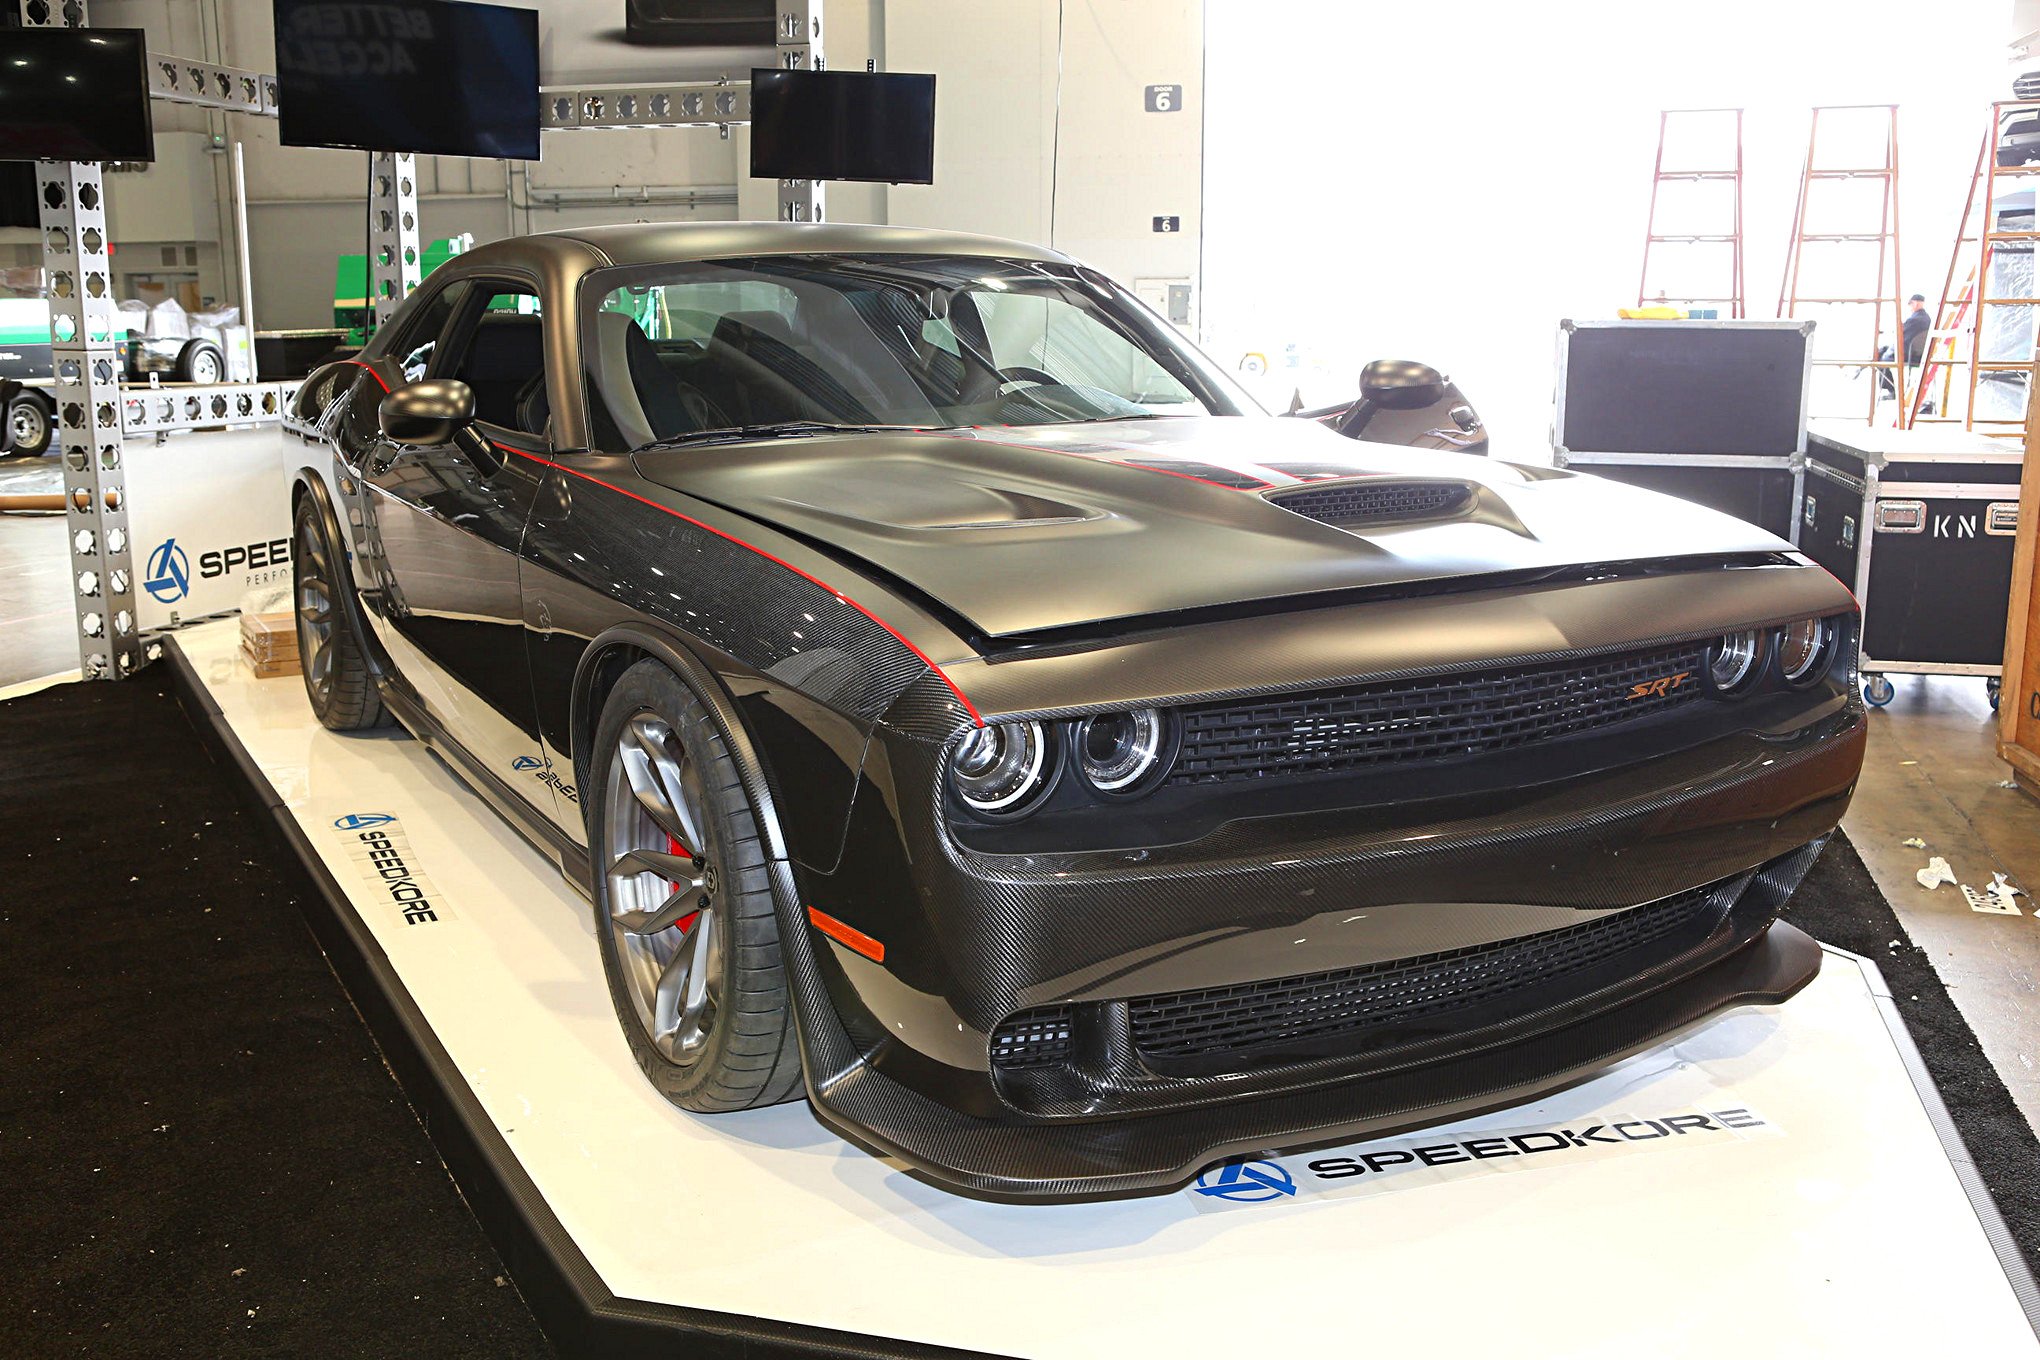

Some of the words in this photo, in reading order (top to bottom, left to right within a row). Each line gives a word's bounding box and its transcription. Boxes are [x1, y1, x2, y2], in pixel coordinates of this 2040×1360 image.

[1155, 92, 1171, 111] 6
[1162, 219, 1171, 232] 6
[200, 537, 295, 579] SPEE
[1624, 672, 1690, 701] SRT
[358, 830, 438, 926] SPEEDKORE
[1308, 1108, 1767, 1180] SPEEDKORE
